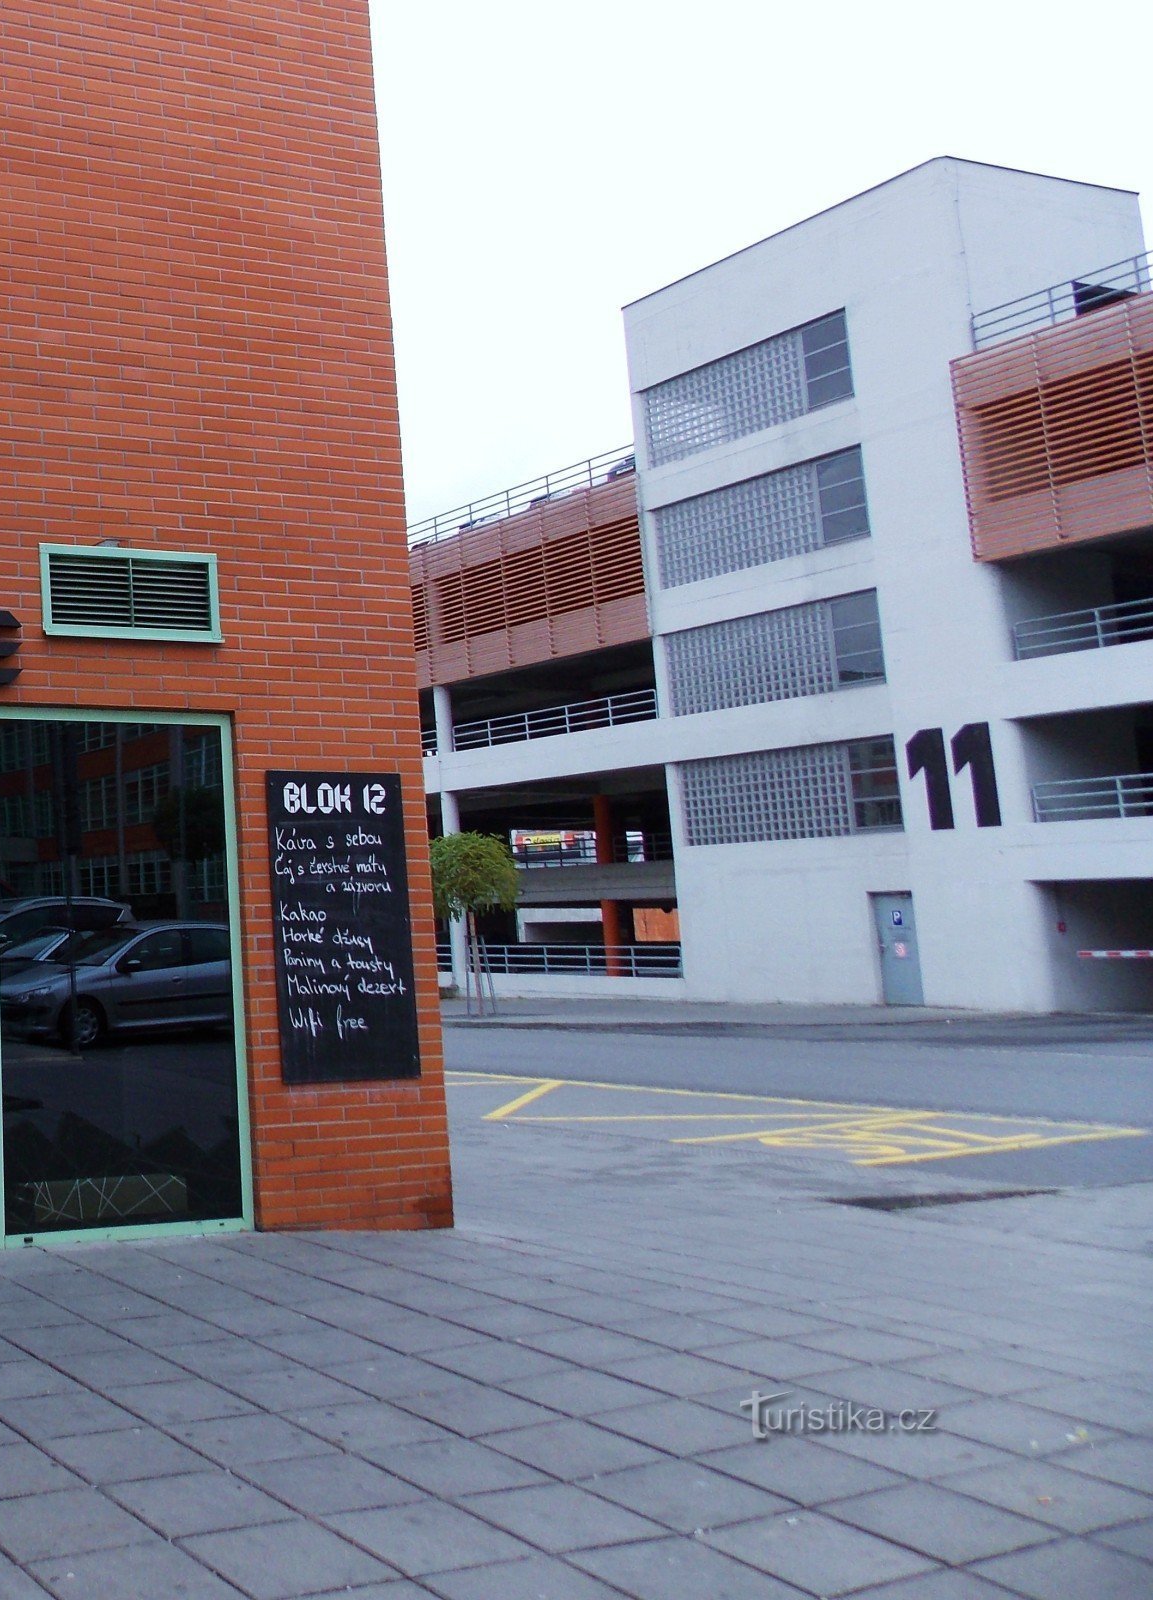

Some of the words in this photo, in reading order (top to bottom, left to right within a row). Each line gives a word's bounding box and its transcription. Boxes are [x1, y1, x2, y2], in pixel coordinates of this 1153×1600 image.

[905, 722, 1002, 830] 11
[283, 782, 352, 814] BLOK
[363, 783, 386, 814] 12
[275, 826, 316, 850] Káva
[326, 835, 335, 849] s
[345, 825, 383, 847] sebou
[275, 852, 295, 884] Čaj
[297, 864, 305, 875] s
[309, 855, 350, 875] čerstvé
[356, 853, 387, 875] máty
[325, 883, 335, 893] a
[342, 876, 392, 893] zázvoru
[280, 900, 327, 922] Kakao
[282, 926, 325, 943] Horké
[332, 927, 374, 954] džusy
[283, 948, 326, 974] Paniny
[331, 958, 342, 969] a
[346, 952, 395, 980] tousty
[287, 973, 351, 1001] Malinový
[357, 977, 407, 995] dezert
[336, 1003, 369, 1039] free
